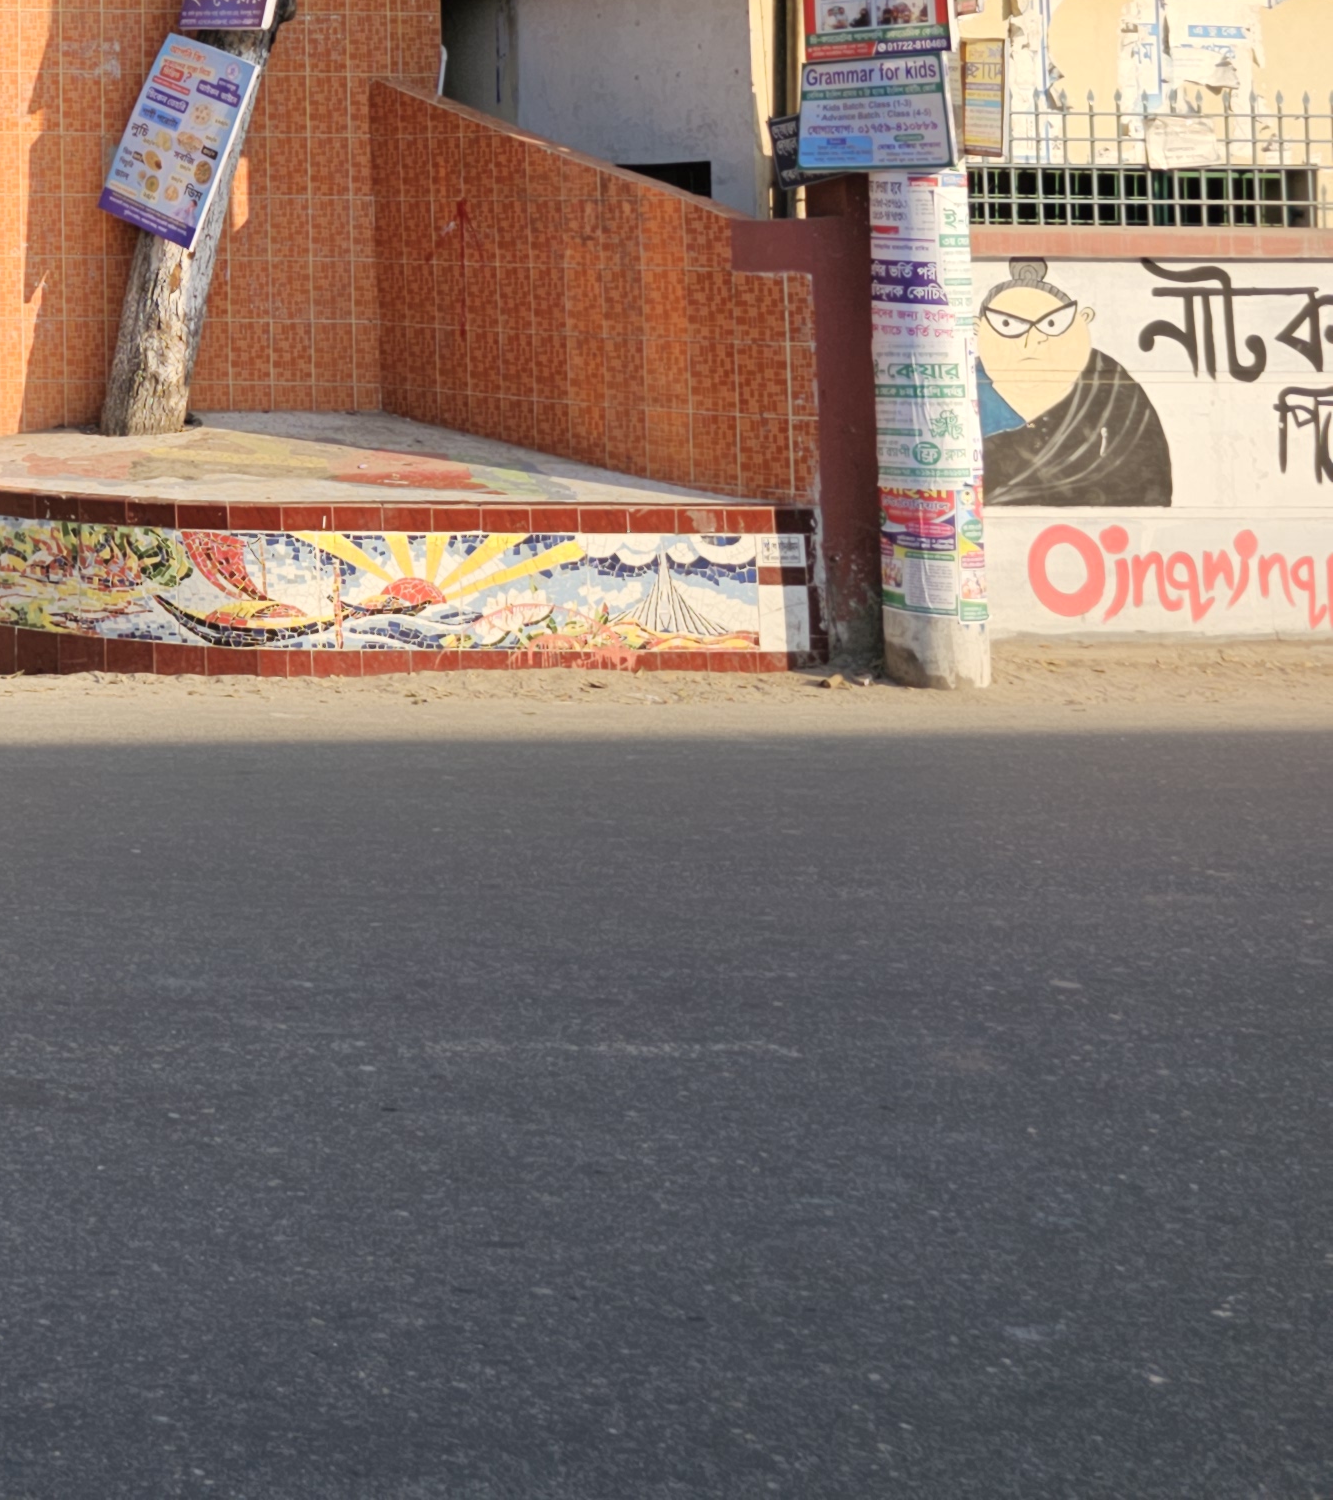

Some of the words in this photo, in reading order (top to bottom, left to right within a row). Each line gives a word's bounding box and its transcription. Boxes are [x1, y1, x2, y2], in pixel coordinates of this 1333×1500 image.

[805, 67, 875, 86] Grammar
[878, 62, 900, 81] for
[905, 60, 937, 79] kids
[822, 104, 841, 112] Kids
[842, 102, 866, 110] Batch:
[868, 100, 891, 109] Class
[893, 99, 912, 109] (1-3)
[821, 112, 856, 122] Advance
[857, 111, 881, 120] Batch
[887, 109, 911, 118] Class
[888, 261, 914, 278] ভর্তি
[906, 282, 947, 303] কোচিং
[896, 310, 919, 321] জন্য
[905, 324, 931, 337] ভর্তি
